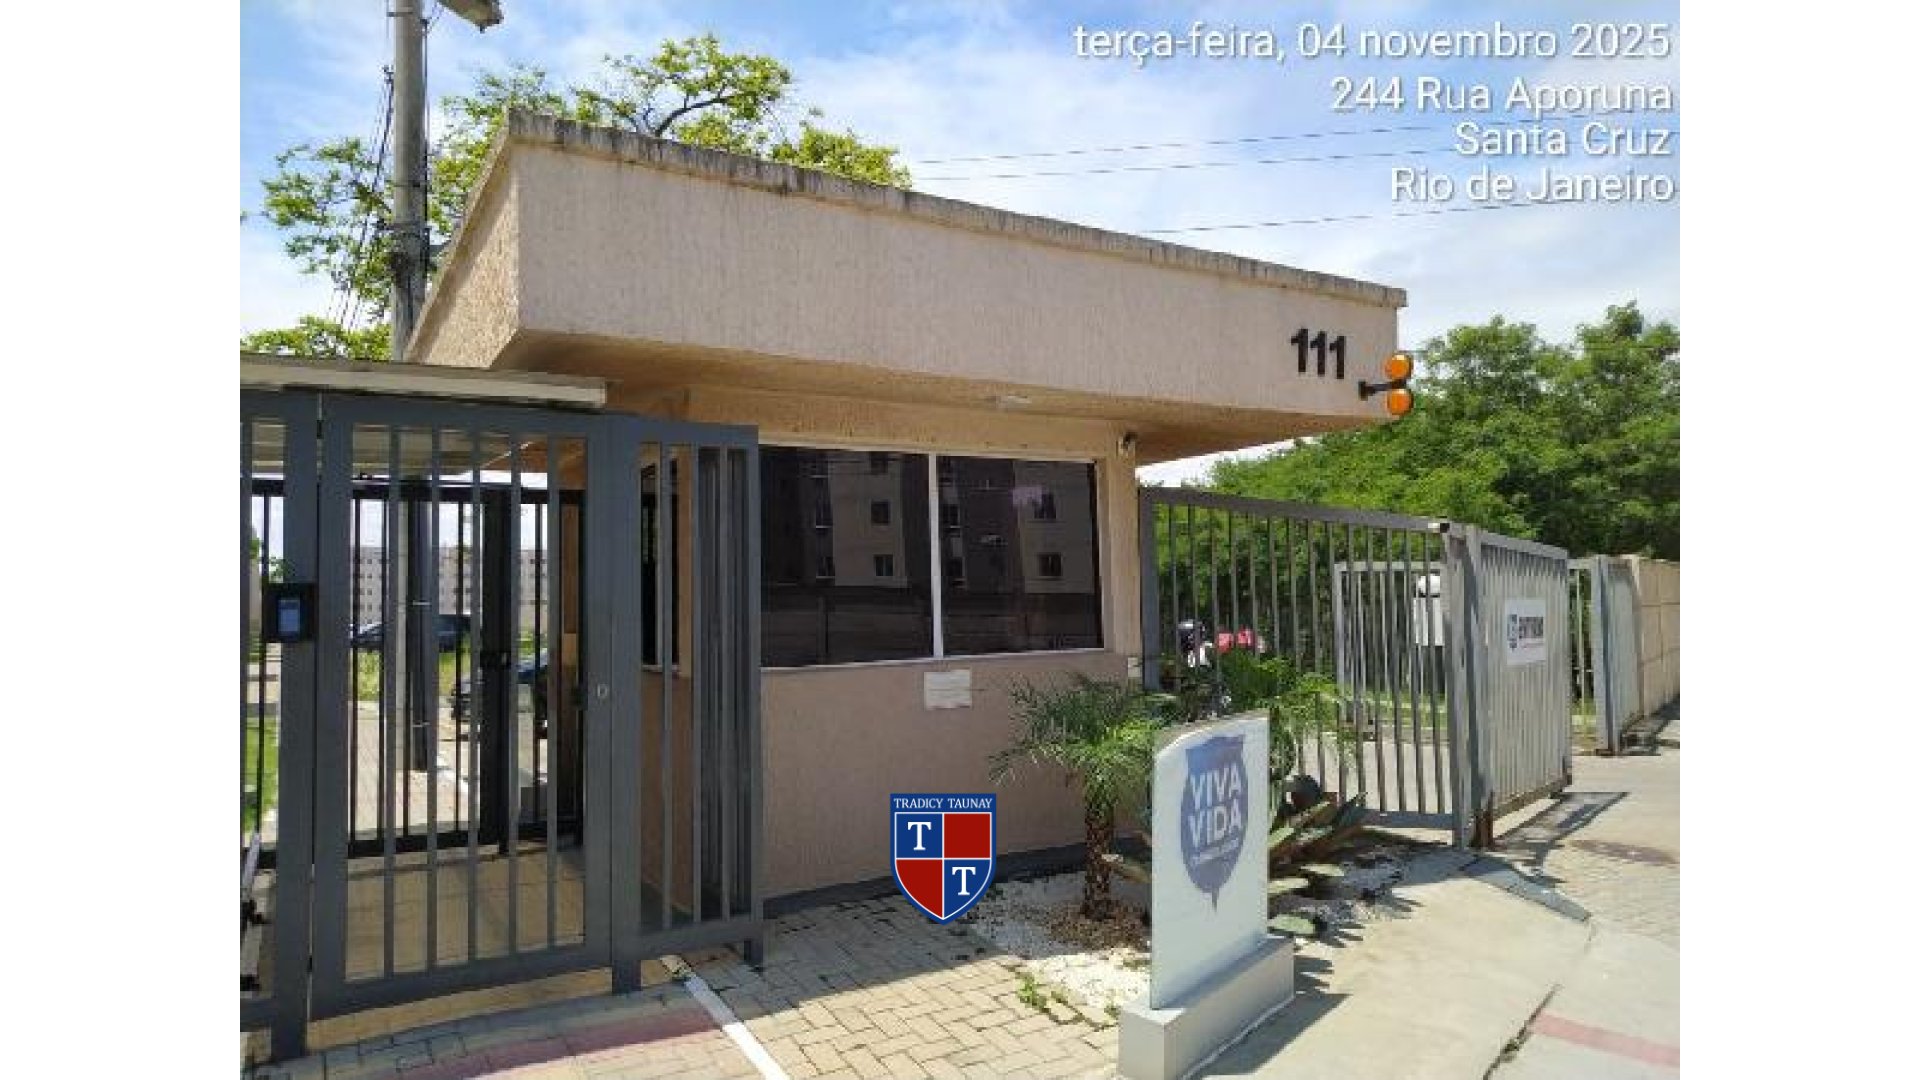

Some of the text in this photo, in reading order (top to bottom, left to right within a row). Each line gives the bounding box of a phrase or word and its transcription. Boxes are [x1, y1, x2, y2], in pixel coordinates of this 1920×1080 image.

[1291, 328, 1346, 379] 111
[1190, 763, 1242, 810] VIVA
[1187, 799, 1242, 848] VIDA
